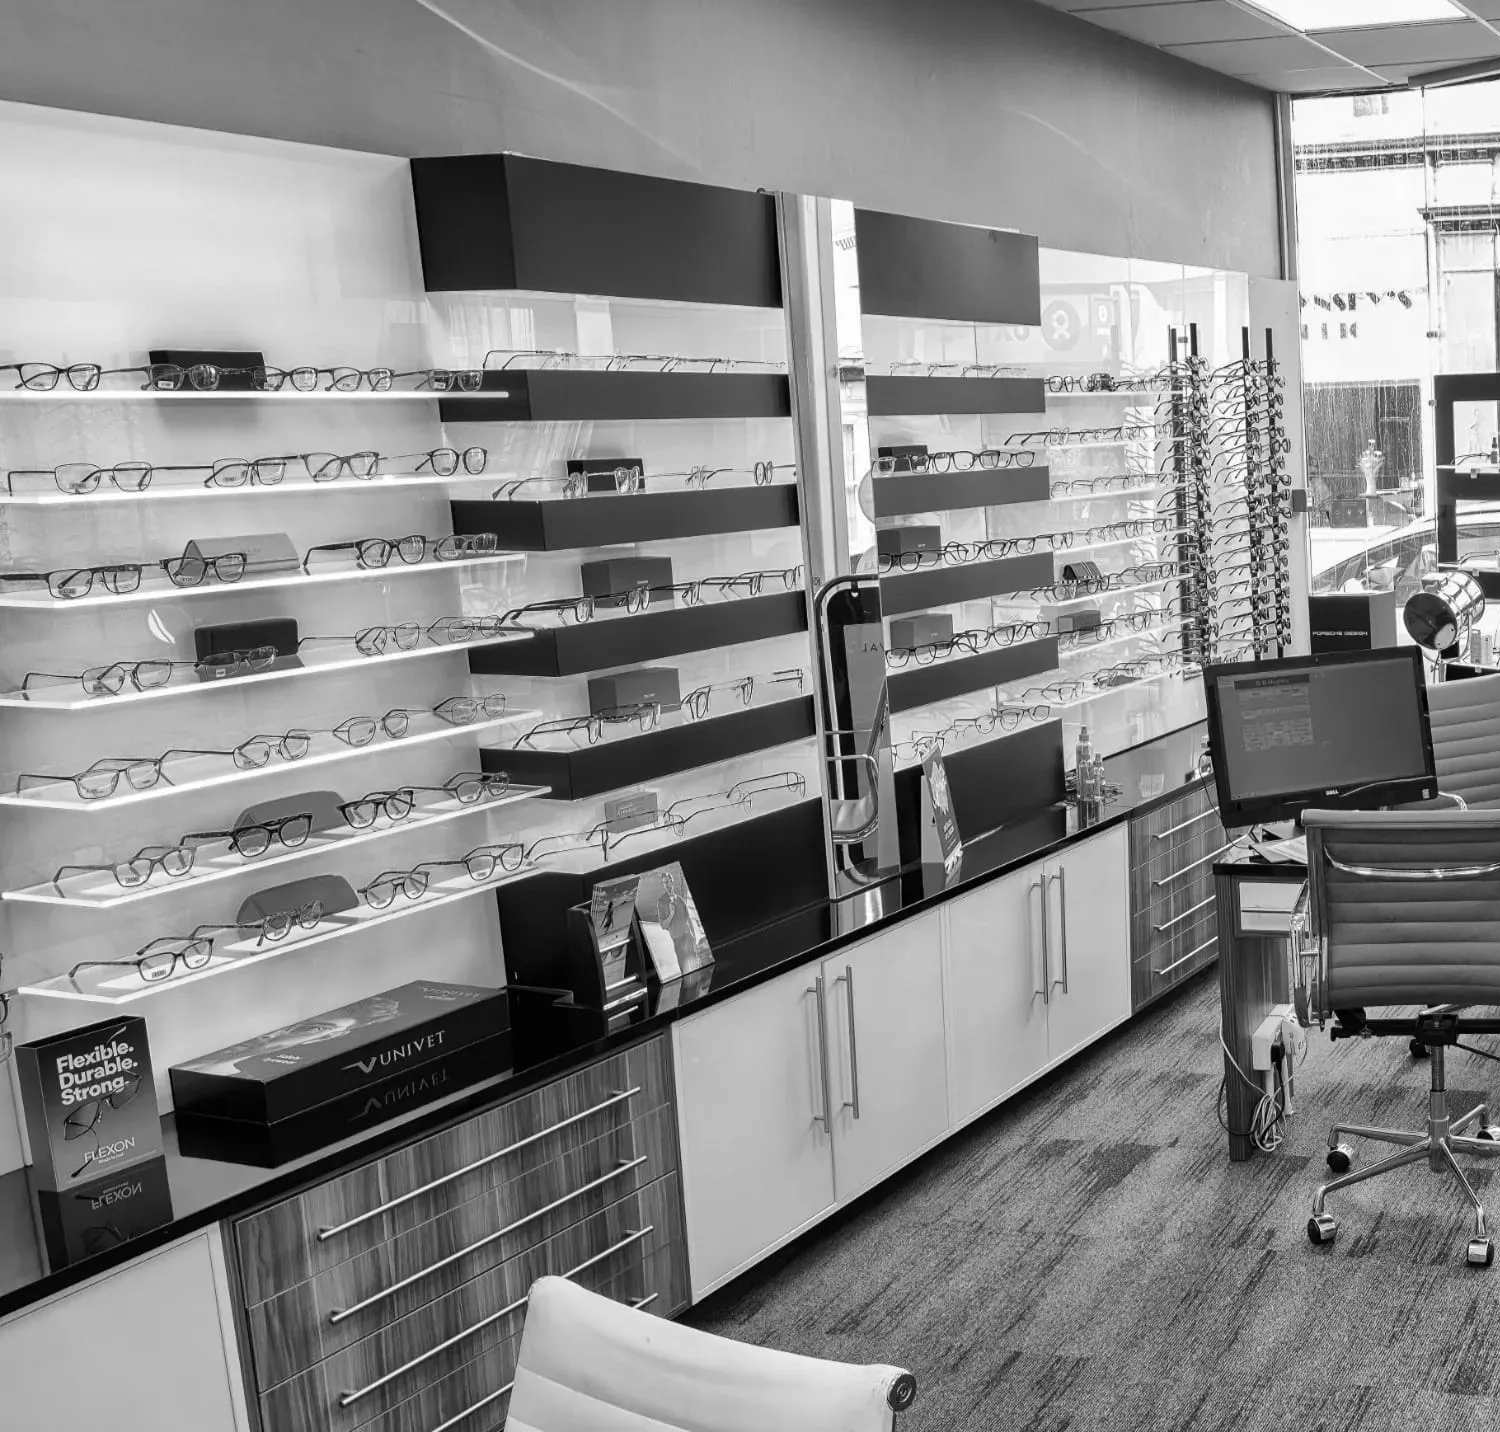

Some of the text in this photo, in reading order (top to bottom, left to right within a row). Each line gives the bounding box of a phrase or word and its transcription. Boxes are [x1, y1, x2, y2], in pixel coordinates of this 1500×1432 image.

[56, 1040, 135, 1075] Flexible.
[379, 1030, 446, 1066] UNIVET
[58, 1056, 139, 1091] Durable.
[60, 1075, 130, 1107] Strong.
[84, 1137, 136, 1164] FLEXON
